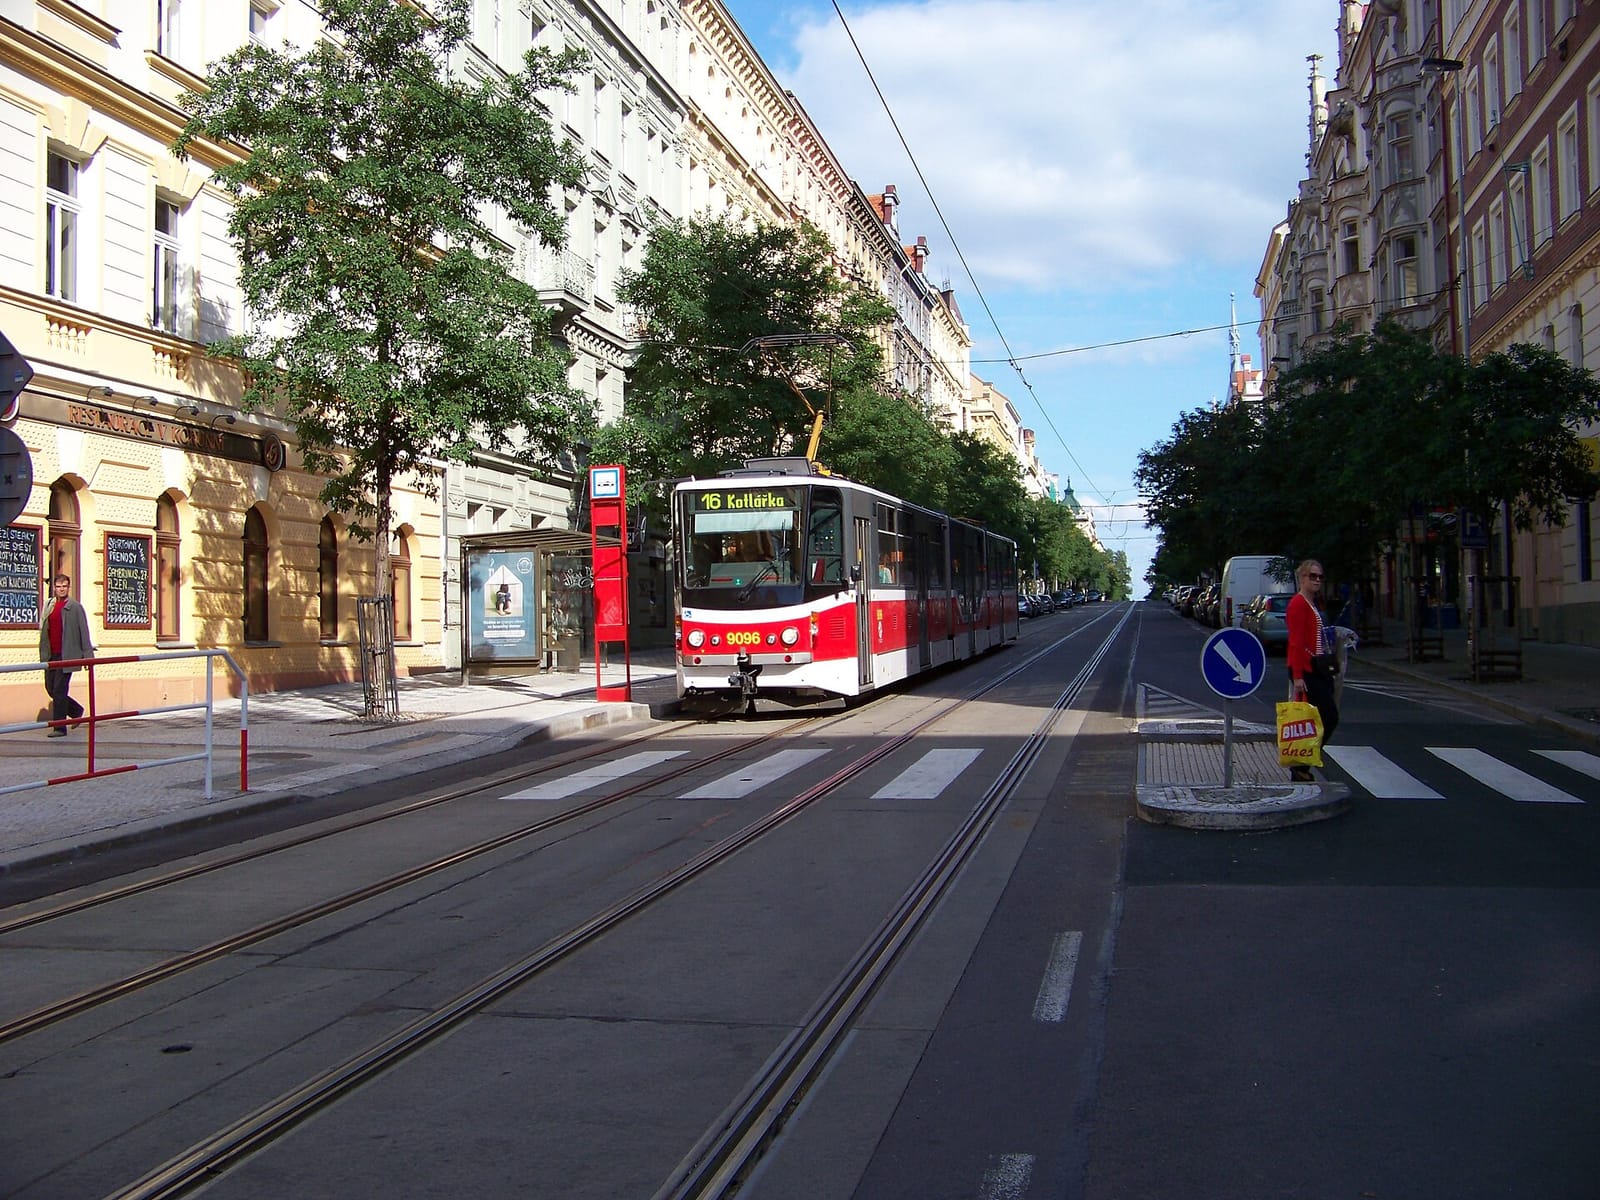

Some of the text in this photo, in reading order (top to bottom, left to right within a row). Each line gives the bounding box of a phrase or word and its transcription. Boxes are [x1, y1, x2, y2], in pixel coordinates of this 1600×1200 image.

[157, 423, 167, 440] V
[702, 492, 784, 509] 16 Kotlářka
[109, 549, 137, 563] PŘENOSY
[0, 593, 37, 608] ZERVACE
[0, 608, 38, 622] 2546591
[726, 632, 761, 645] 9096
[1282, 722, 1314, 739] BILLA
[1282, 742, 1313, 757] dnes
